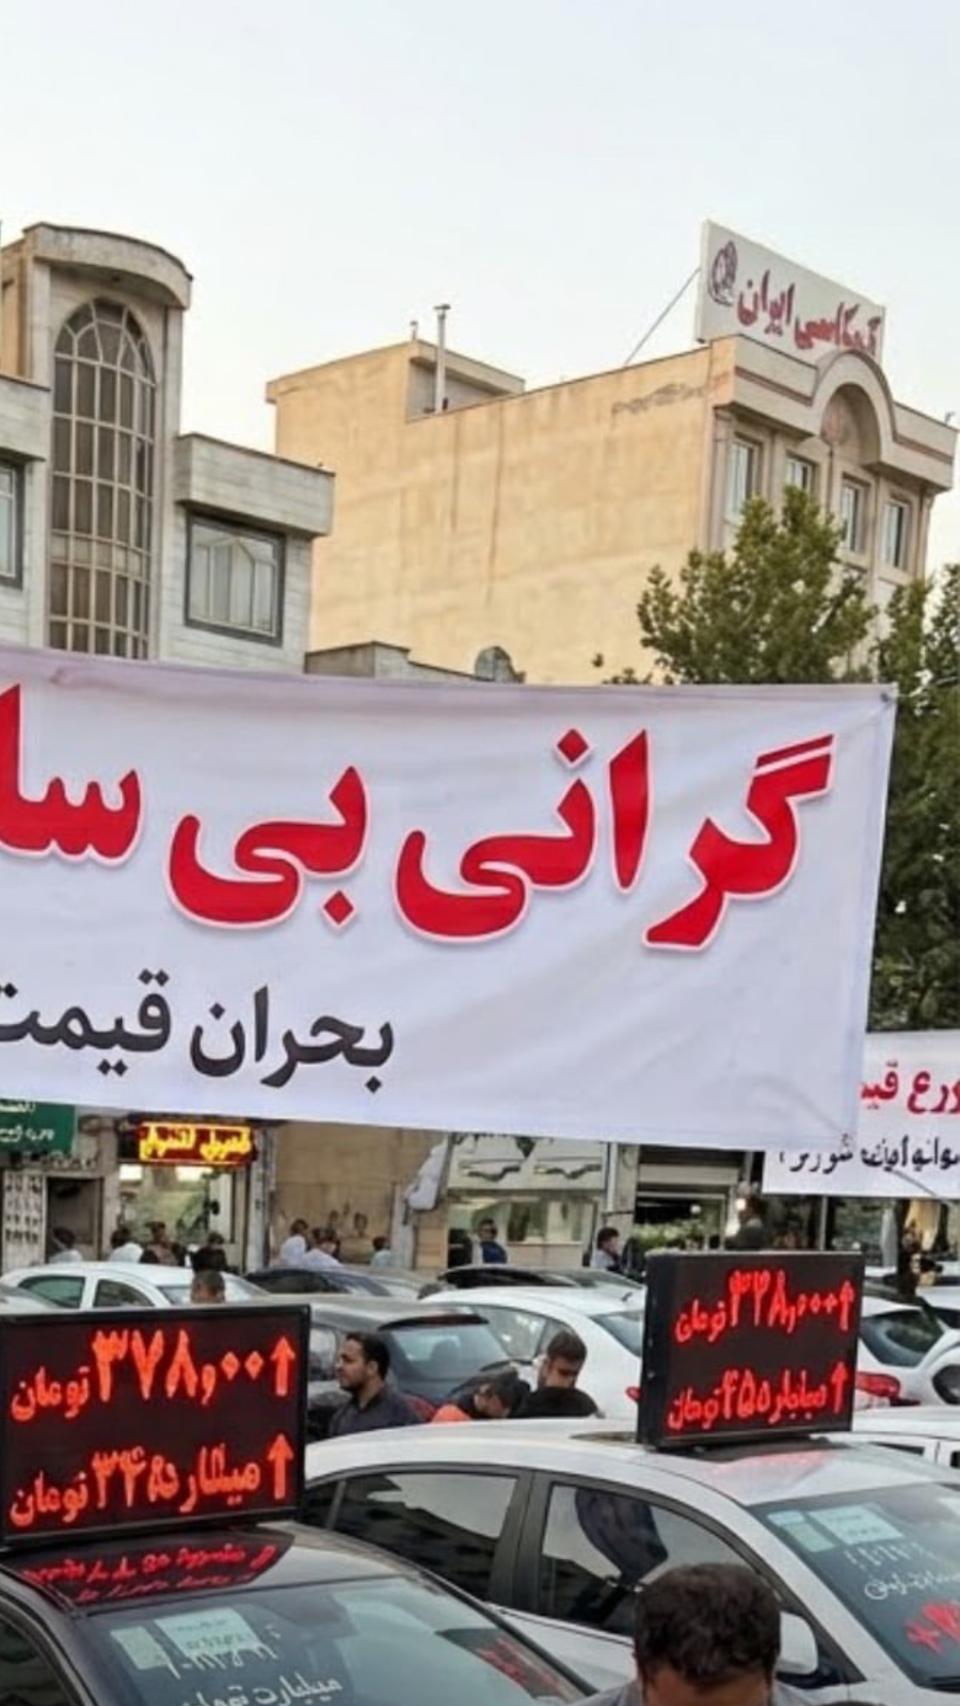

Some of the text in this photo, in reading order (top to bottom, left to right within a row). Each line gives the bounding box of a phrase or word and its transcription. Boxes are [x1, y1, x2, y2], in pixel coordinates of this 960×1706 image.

[167, 766, 367, 926] بی
[396, 730, 831, 948] گرانی
[189, 985, 395, 1093] بحران
